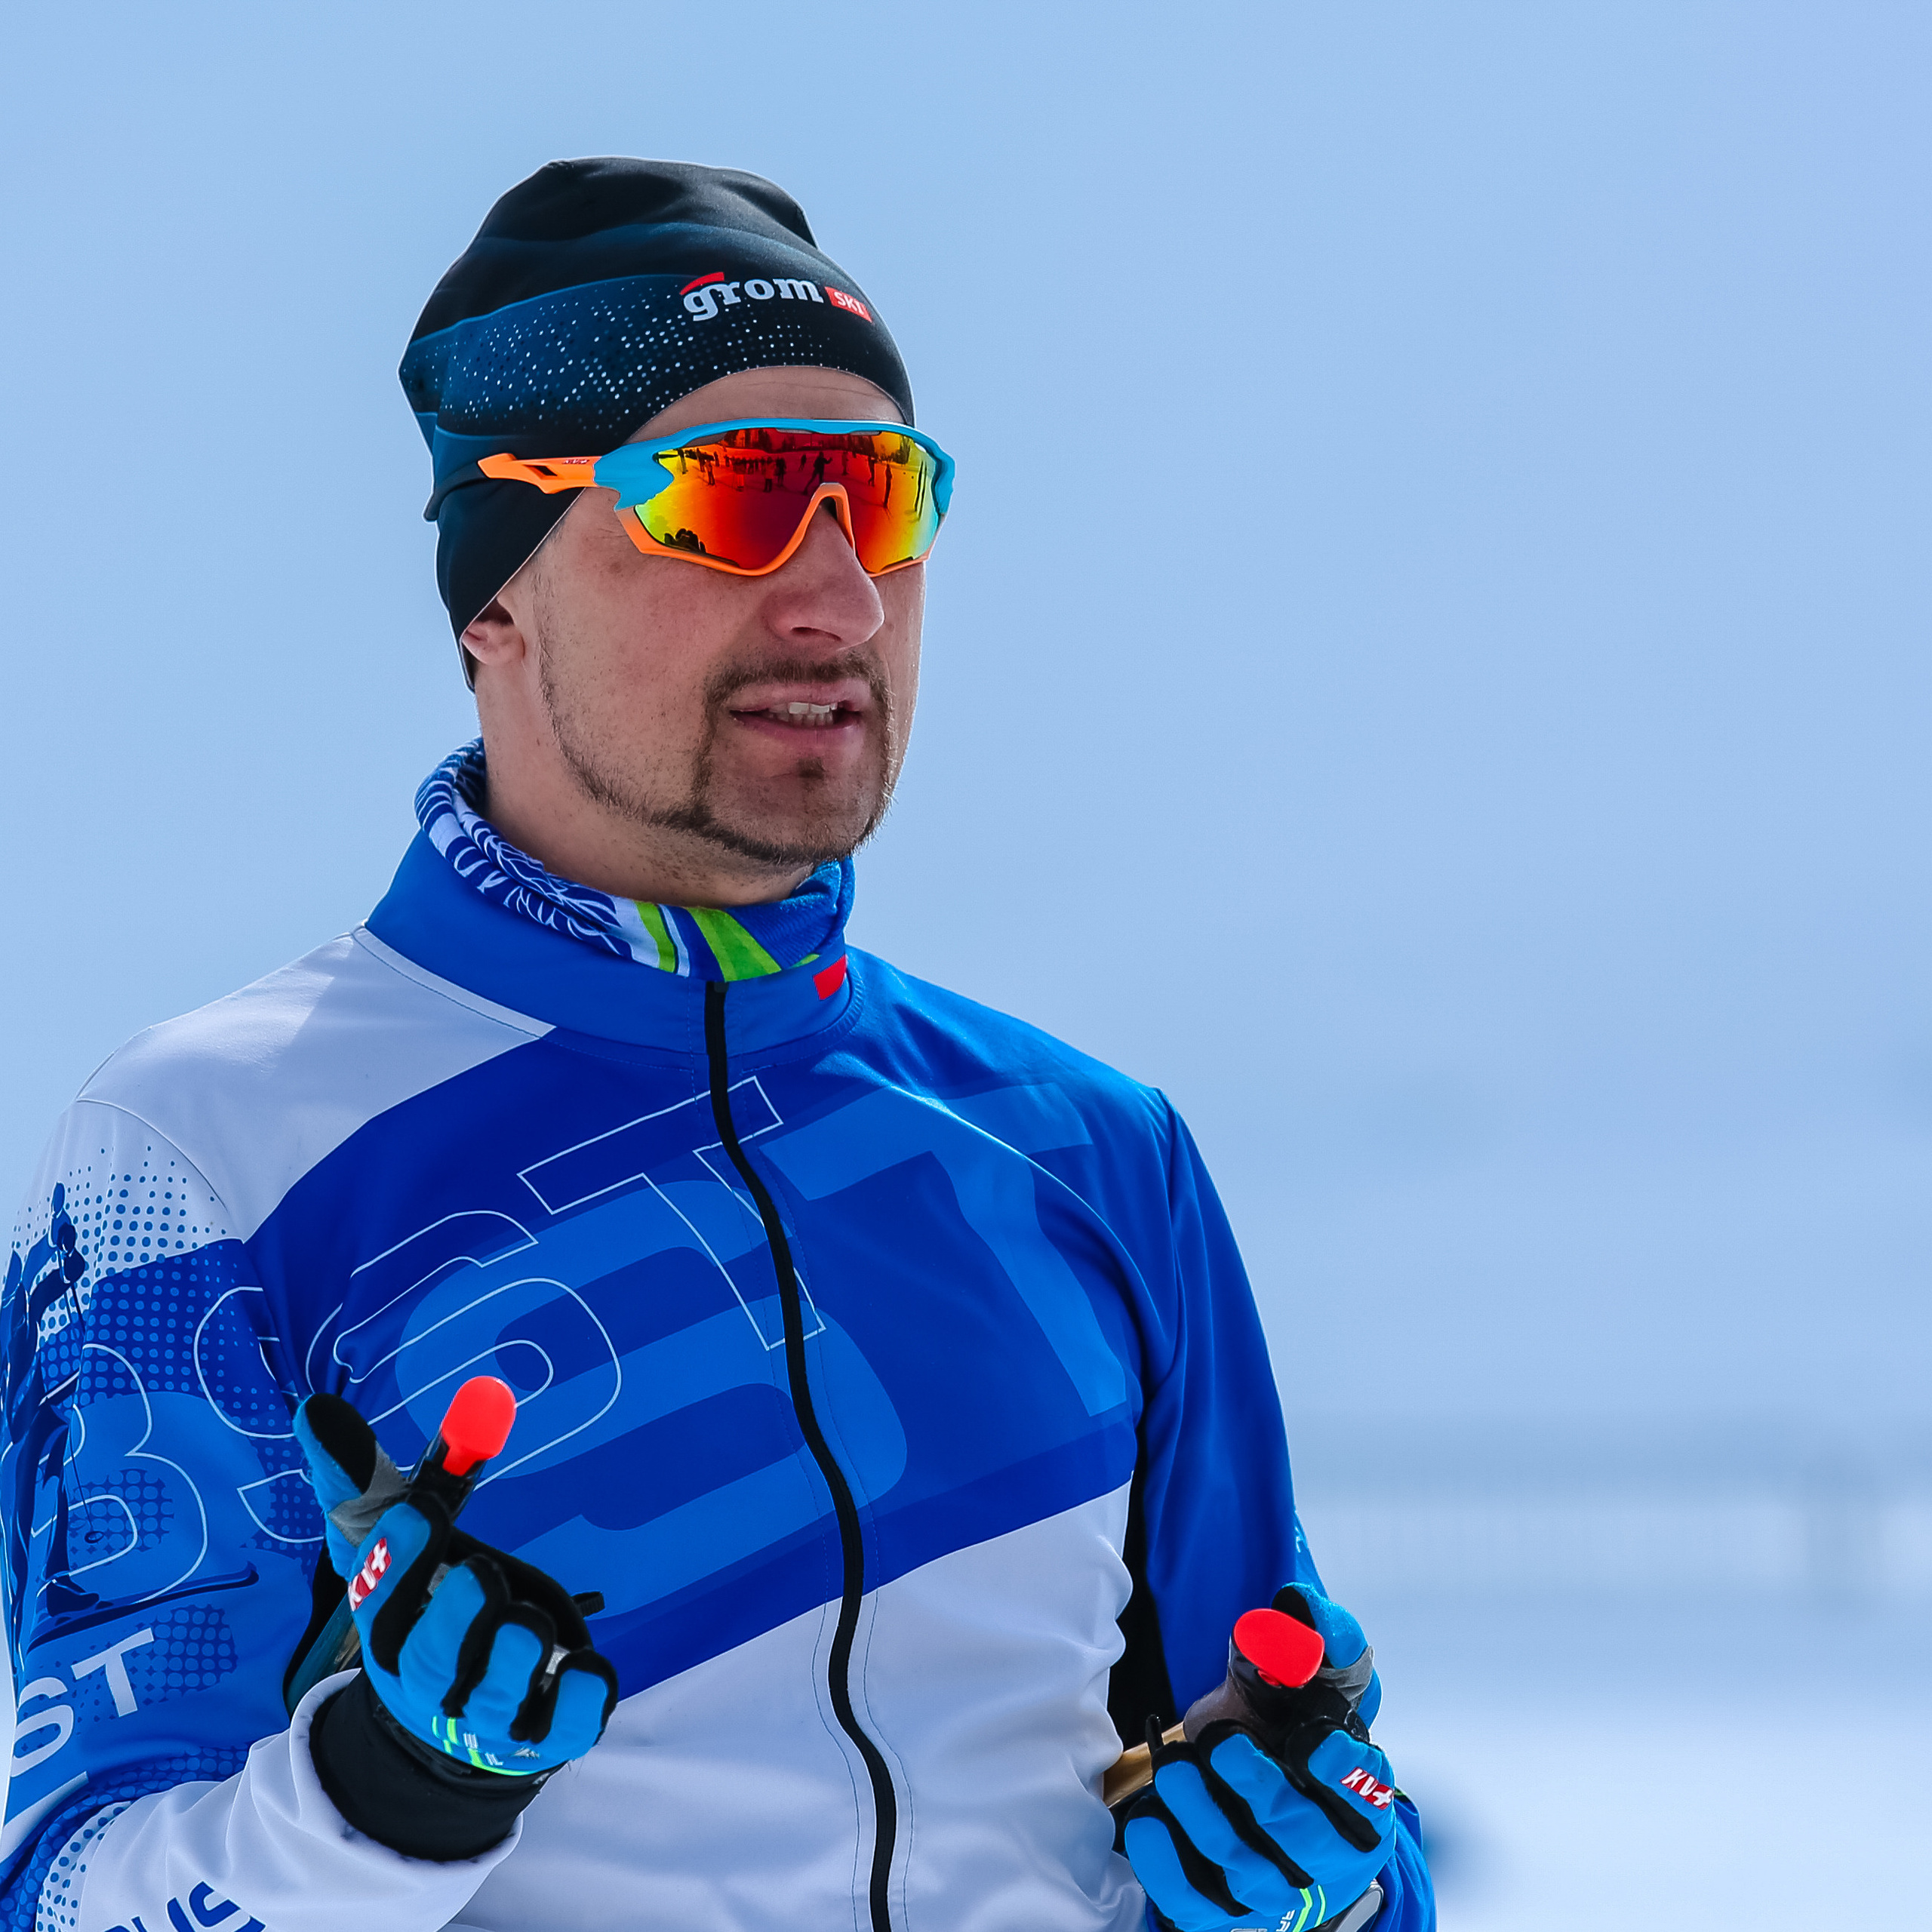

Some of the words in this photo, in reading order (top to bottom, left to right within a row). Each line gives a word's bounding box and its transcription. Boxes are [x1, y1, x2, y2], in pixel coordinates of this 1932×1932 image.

[683, 278, 824, 321] grom
[833, 291, 865, 315] SKI
[1341, 1767, 1394, 1807] KV+
